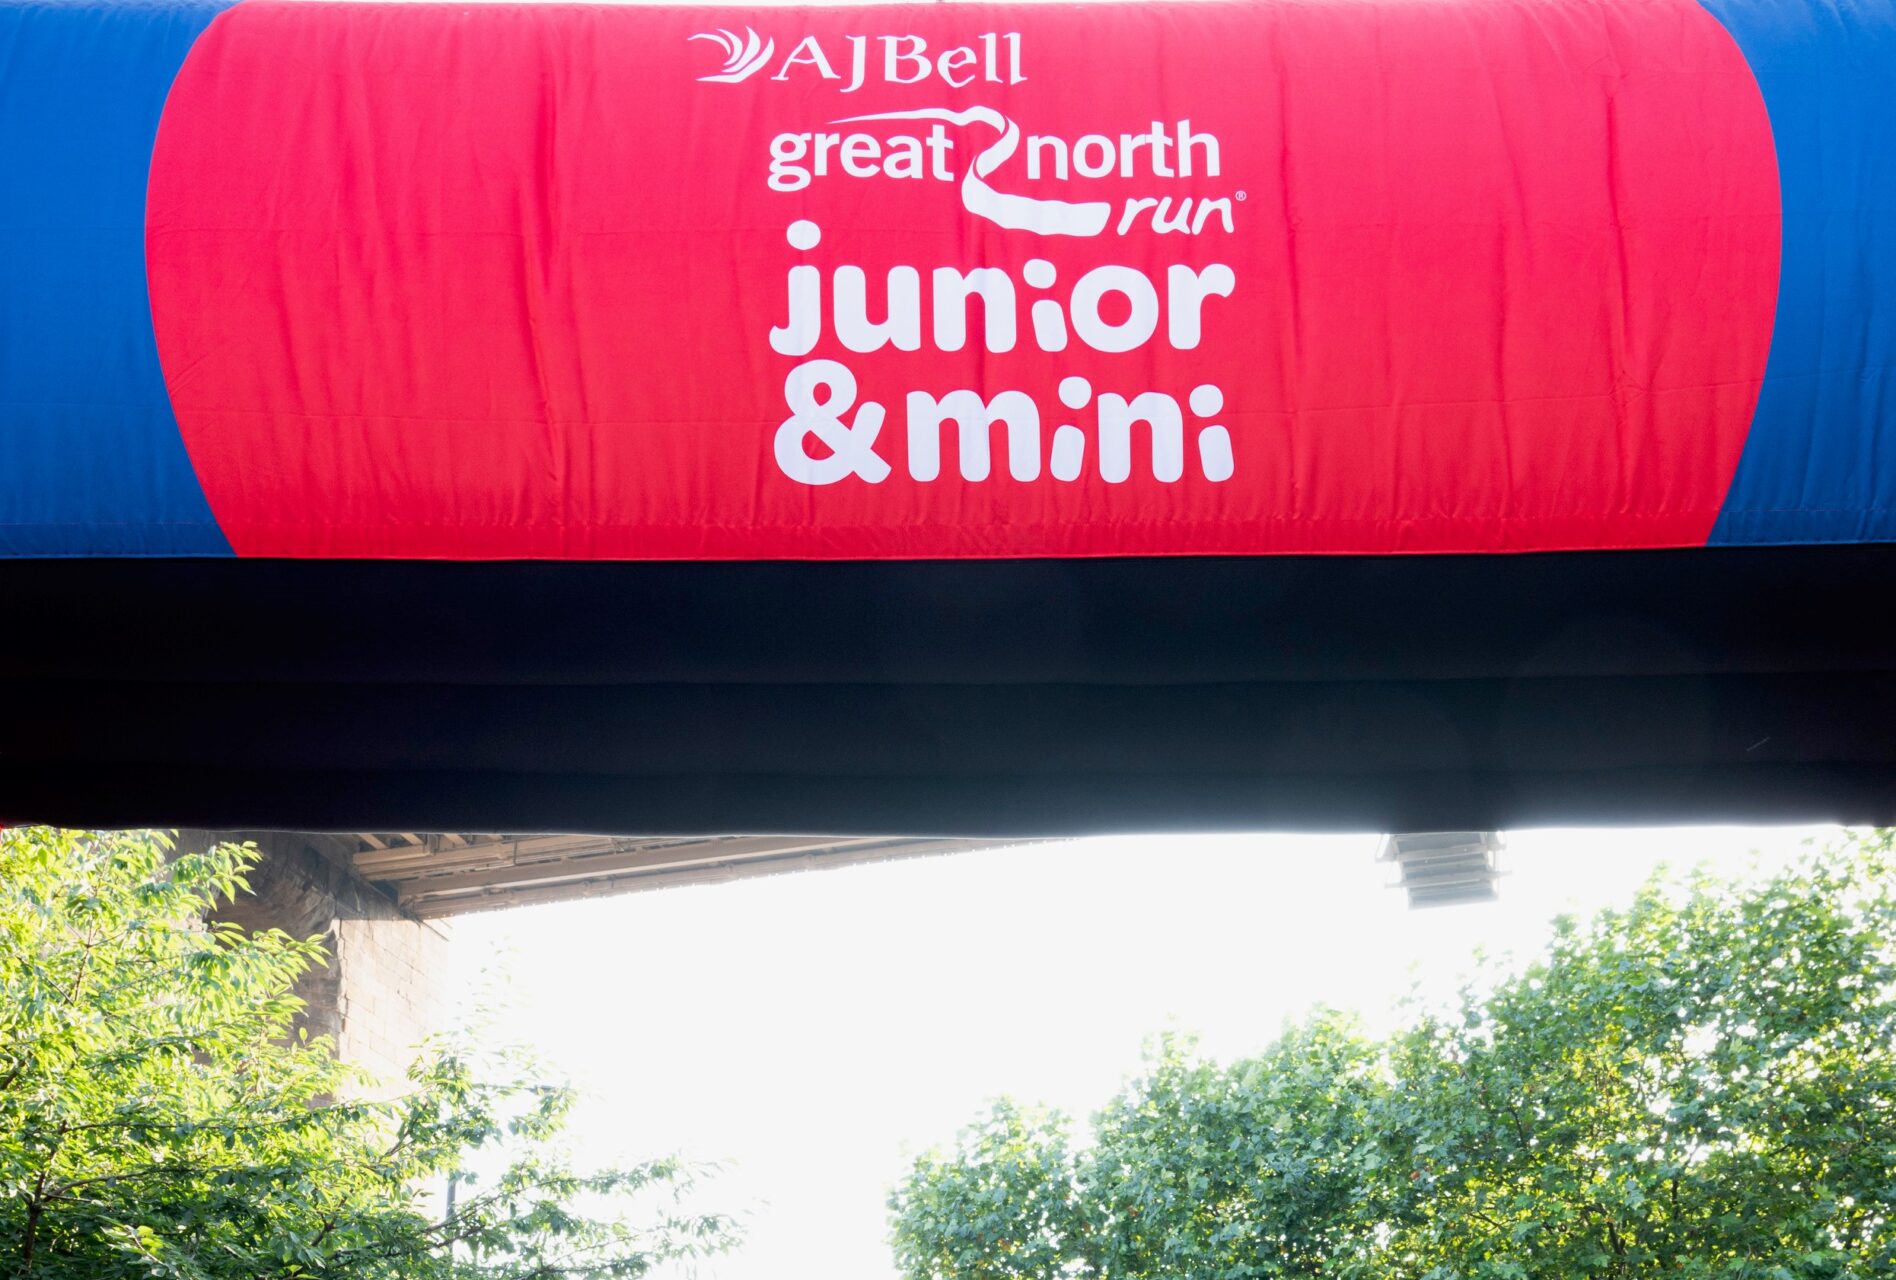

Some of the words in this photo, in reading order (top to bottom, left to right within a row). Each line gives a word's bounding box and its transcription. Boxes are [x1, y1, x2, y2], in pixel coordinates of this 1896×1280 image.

[767, 124, 954, 192] great
[1027, 119, 1220, 181] north
[768, 219, 1236, 356] junior
